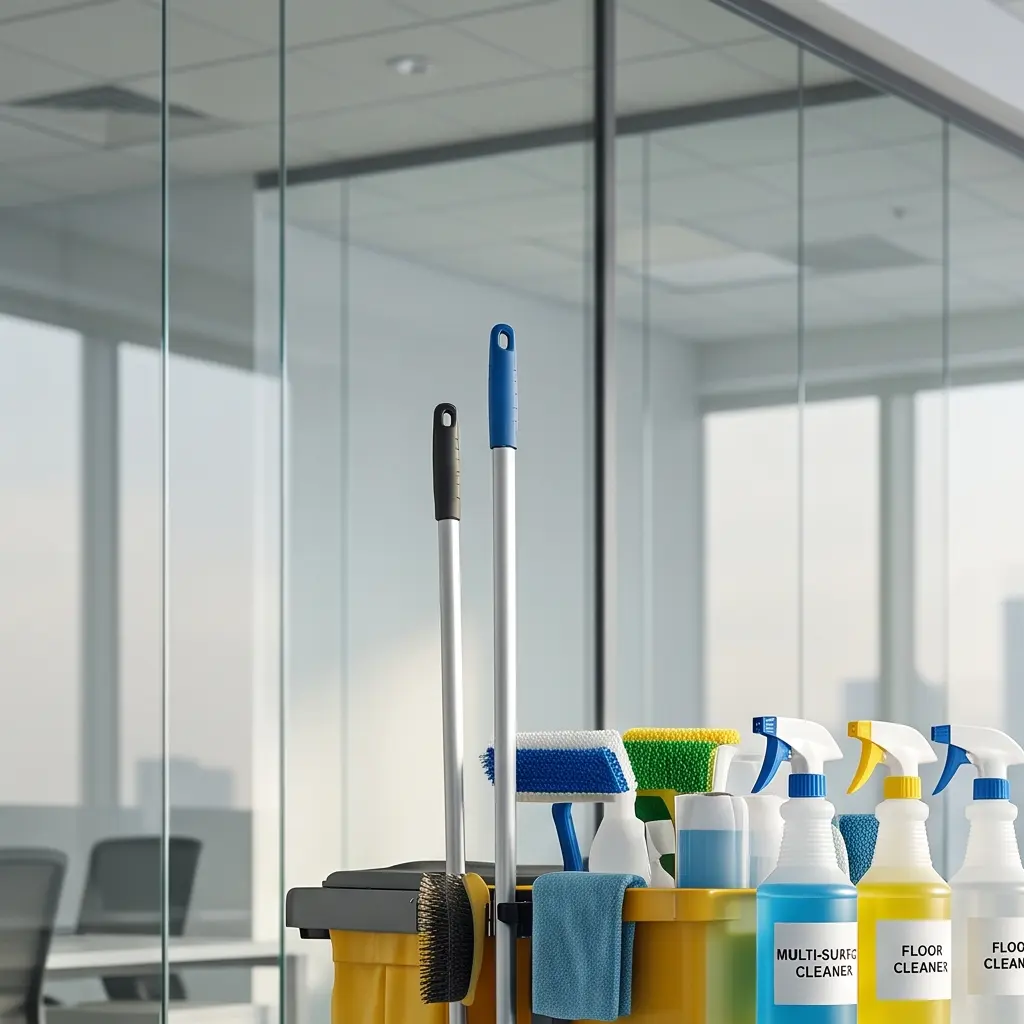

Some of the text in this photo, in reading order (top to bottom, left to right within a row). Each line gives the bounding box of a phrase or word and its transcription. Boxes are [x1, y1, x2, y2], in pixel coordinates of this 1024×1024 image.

[902, 944, 943, 957] FLOOR
[796, 965, 853, 978] CLEANER
[893, 961, 948, 974] CLEANER
